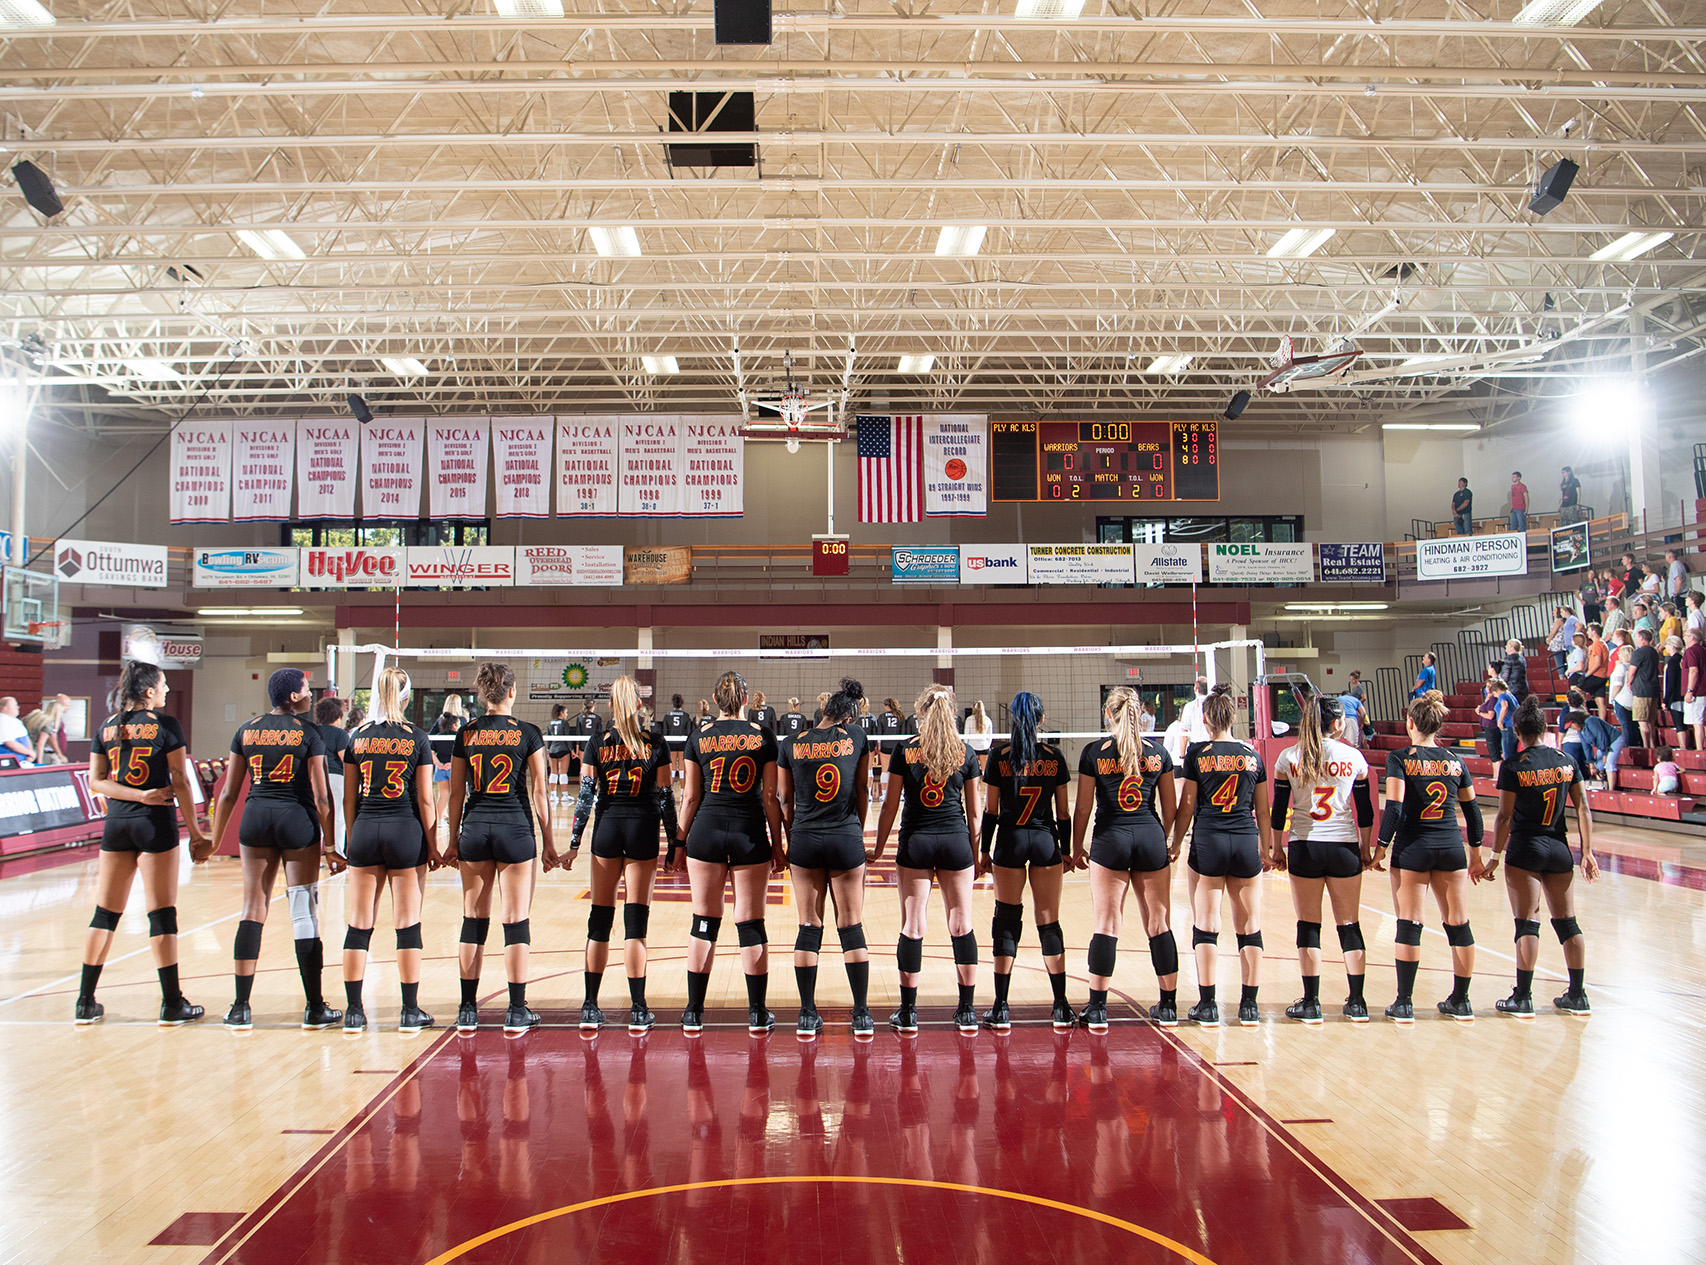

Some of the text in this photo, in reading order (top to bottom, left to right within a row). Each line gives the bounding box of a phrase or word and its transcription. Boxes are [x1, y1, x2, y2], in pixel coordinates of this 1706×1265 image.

[562, 426, 612, 438] NJCAA
[626, 425, 676, 436] NJCAA
[688, 426, 738, 437] NJCAA
[940, 424, 969, 433] NATIONAL
[994, 424, 1035, 432] PLY AC KLS
[1092, 424, 1128, 440] 0:00
[1174, 424, 1215, 432] PLY AC KLS
[178, 432, 226, 444] NJCAA
[240, 432, 288, 443] NJCAA
[306, 429, 350, 440] NJCAA
[369, 429, 415, 440] NJCAA
[436, 429, 481, 441] NJCAA
[500, 430, 545, 441] NJCAA
[929, 435, 980, 444] INTERCOLLEGIATE
[1183, 433, 1214, 442] 3 0 0
[944, 447, 966, 456] RECORD
[1044, 443, 1078, 451] WARRIORS
[1138, 443, 1159, 451] BEARS
[1182, 444, 1215, 453] 4 0 0
[311, 458, 343, 468] NATIONAL
[441, 459, 474, 470] NATIONAL
[1064, 454, 1162, 469] 0 1 0
[1182, 455, 1215, 464] 8 0 0
[243, 465, 283, 475] NATIONAL
[372, 463, 410, 474] NATIONAL
[506, 460, 539, 470] NATIONAL
[565, 460, 609, 471] NATIONAL
[628, 460, 672, 470] NATIONAL
[690, 460, 733, 470] NATIONAL
[180, 466, 220, 477] NATIONAL
[308, 471, 346, 481] CHAMPIONS
[439, 473, 476, 484] CHAMPIONS
[504, 474, 541, 485] CHAMPIONS
[563, 474, 612, 485] CHAMPIONS
[624, 475, 676, 485] CHAMPIONS
[686, 475, 737, 485] CHAMPIONS
[1047, 474, 1061, 482] WON
[1095, 474, 1118, 482] MATCH
[1150, 474, 1163, 482] WON
[176, 481, 224, 492] CHAMPIONS
[239, 480, 287, 490] CHAMPIONS
[319, 484, 334, 494] 2012
[370, 479, 412, 489] CHAMPIONS
[938, 483, 965, 491] STRAIGHT
[450, 488, 466, 498] 2015
[514, 488, 529, 498] 2018
[577, 488, 597, 499] 1997
[639, 490, 659, 500] 1998
[701, 490, 721, 500] 1999
[1053, 485, 1163, 498] 0 2 1 2 0
[253, 494, 272, 504] 2011
[381, 493, 399, 503] 2014
[525, 548, 567, 557] REED
[822, 544, 846, 554] 0:00
[1030, 547, 1130, 555] TURNER CONCRETE CONSTRUCTION
[1216, 545, 1260, 555] NOEL
[1343, 545, 1380, 557] TEAM
[87, 551, 163, 574] Ottumwa
[202, 553, 288, 565] Bowling RVs.com
[627, 553, 666, 563] WAREHOUSE
[898, 554, 956, 563] SCHROEDER
[1151, 558, 1187, 566] Allstate
[1323, 558, 1381, 566] Real Estate
[1424, 557, 1450, 565] HEATING
[1472, 552, 1518, 562] CONDITIONING
[409, 564, 510, 573] WINGER
[531, 565, 572, 575] DOORS
[1454, 564, 1488, 572] 682-3922
[761, 636, 805, 646] INDIAN HILLS
[758, 711, 764, 720] 8
[586, 719, 592, 728] 2
[673, 717, 680, 726] 5
[791, 720, 797, 729] 9
[887, 718, 897, 727] 12
[553, 726, 558, 735] 1
[243, 730, 303, 746] WARRIORS
[463, 730, 522, 746] WARRIORS
[354, 738, 414, 756] WARRIORS
[699, 735, 763, 754] WARRIORS
[793, 738, 853, 760] WARRIORS
[108, 747, 152, 786] 15
[250, 754, 294, 784] 14
[1198, 755, 1258, 773] WARRIORS
[1404, 759, 1462, 776] WARRIORS
[470, 754, 513, 793] 12
[710, 756, 756, 793] 10
[1518, 764, 1574, 787] WARRIORS
[360, 760, 408, 798] 13
[606, 767, 642, 796] 11
[815, 763, 841, 803] 9
[920, 774, 946, 808] 8
[1118, 775, 1143, 812] 6
[1212, 774, 1240, 813] 4
[1310, 786, 1336, 822] 3
[1420, 781, 1447, 820] 2
[1016, 786, 1042, 826] 7
[1542, 788, 1557, 826] 1
